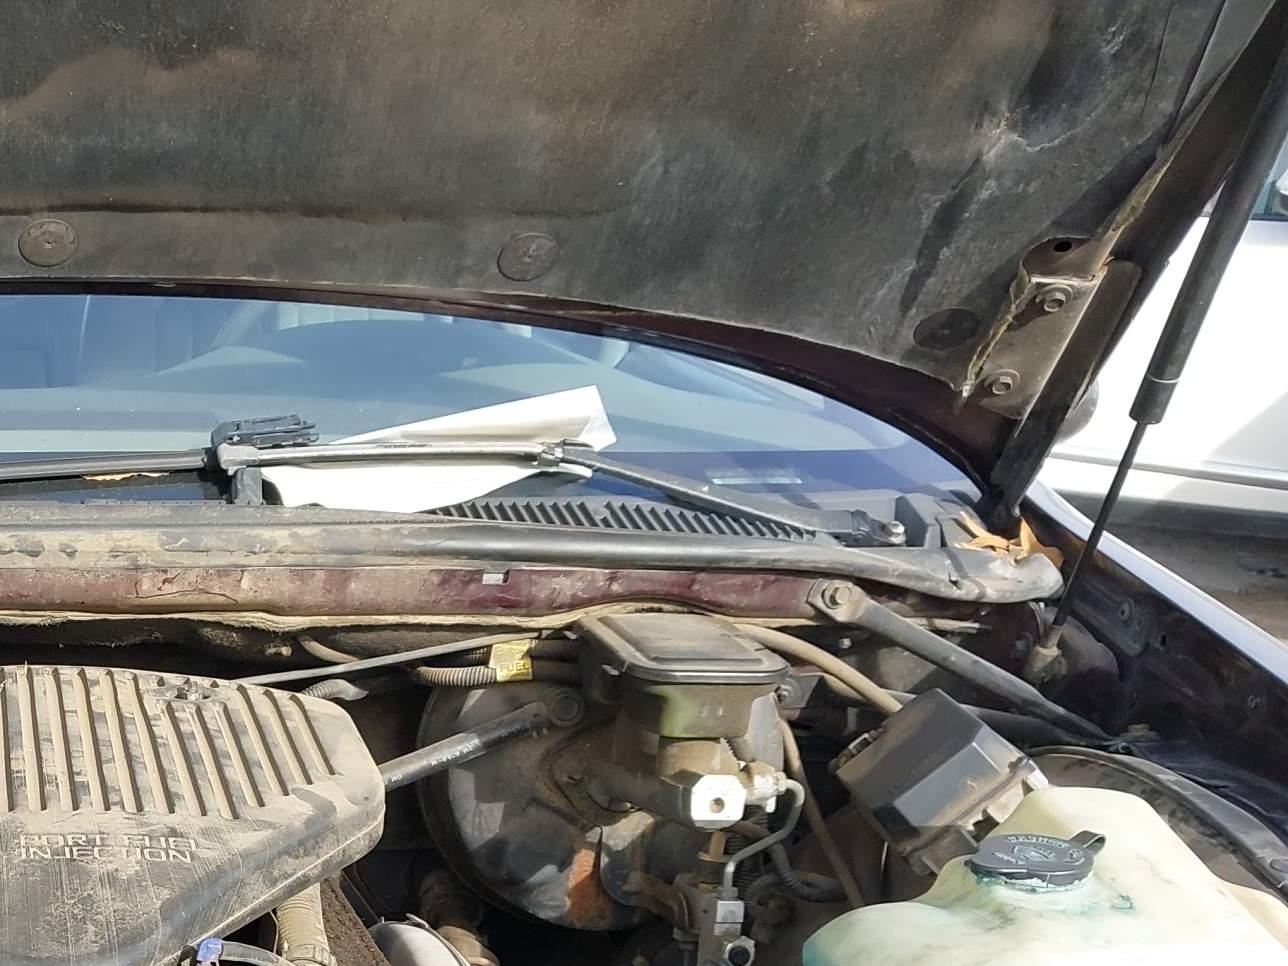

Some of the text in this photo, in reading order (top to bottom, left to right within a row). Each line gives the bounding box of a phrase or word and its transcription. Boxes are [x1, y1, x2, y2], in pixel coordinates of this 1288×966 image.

[500, 663, 529, 672] FUEL
[20, 834, 200, 850] PORT FUEL
[21, 847, 193, 863] INJECTION
